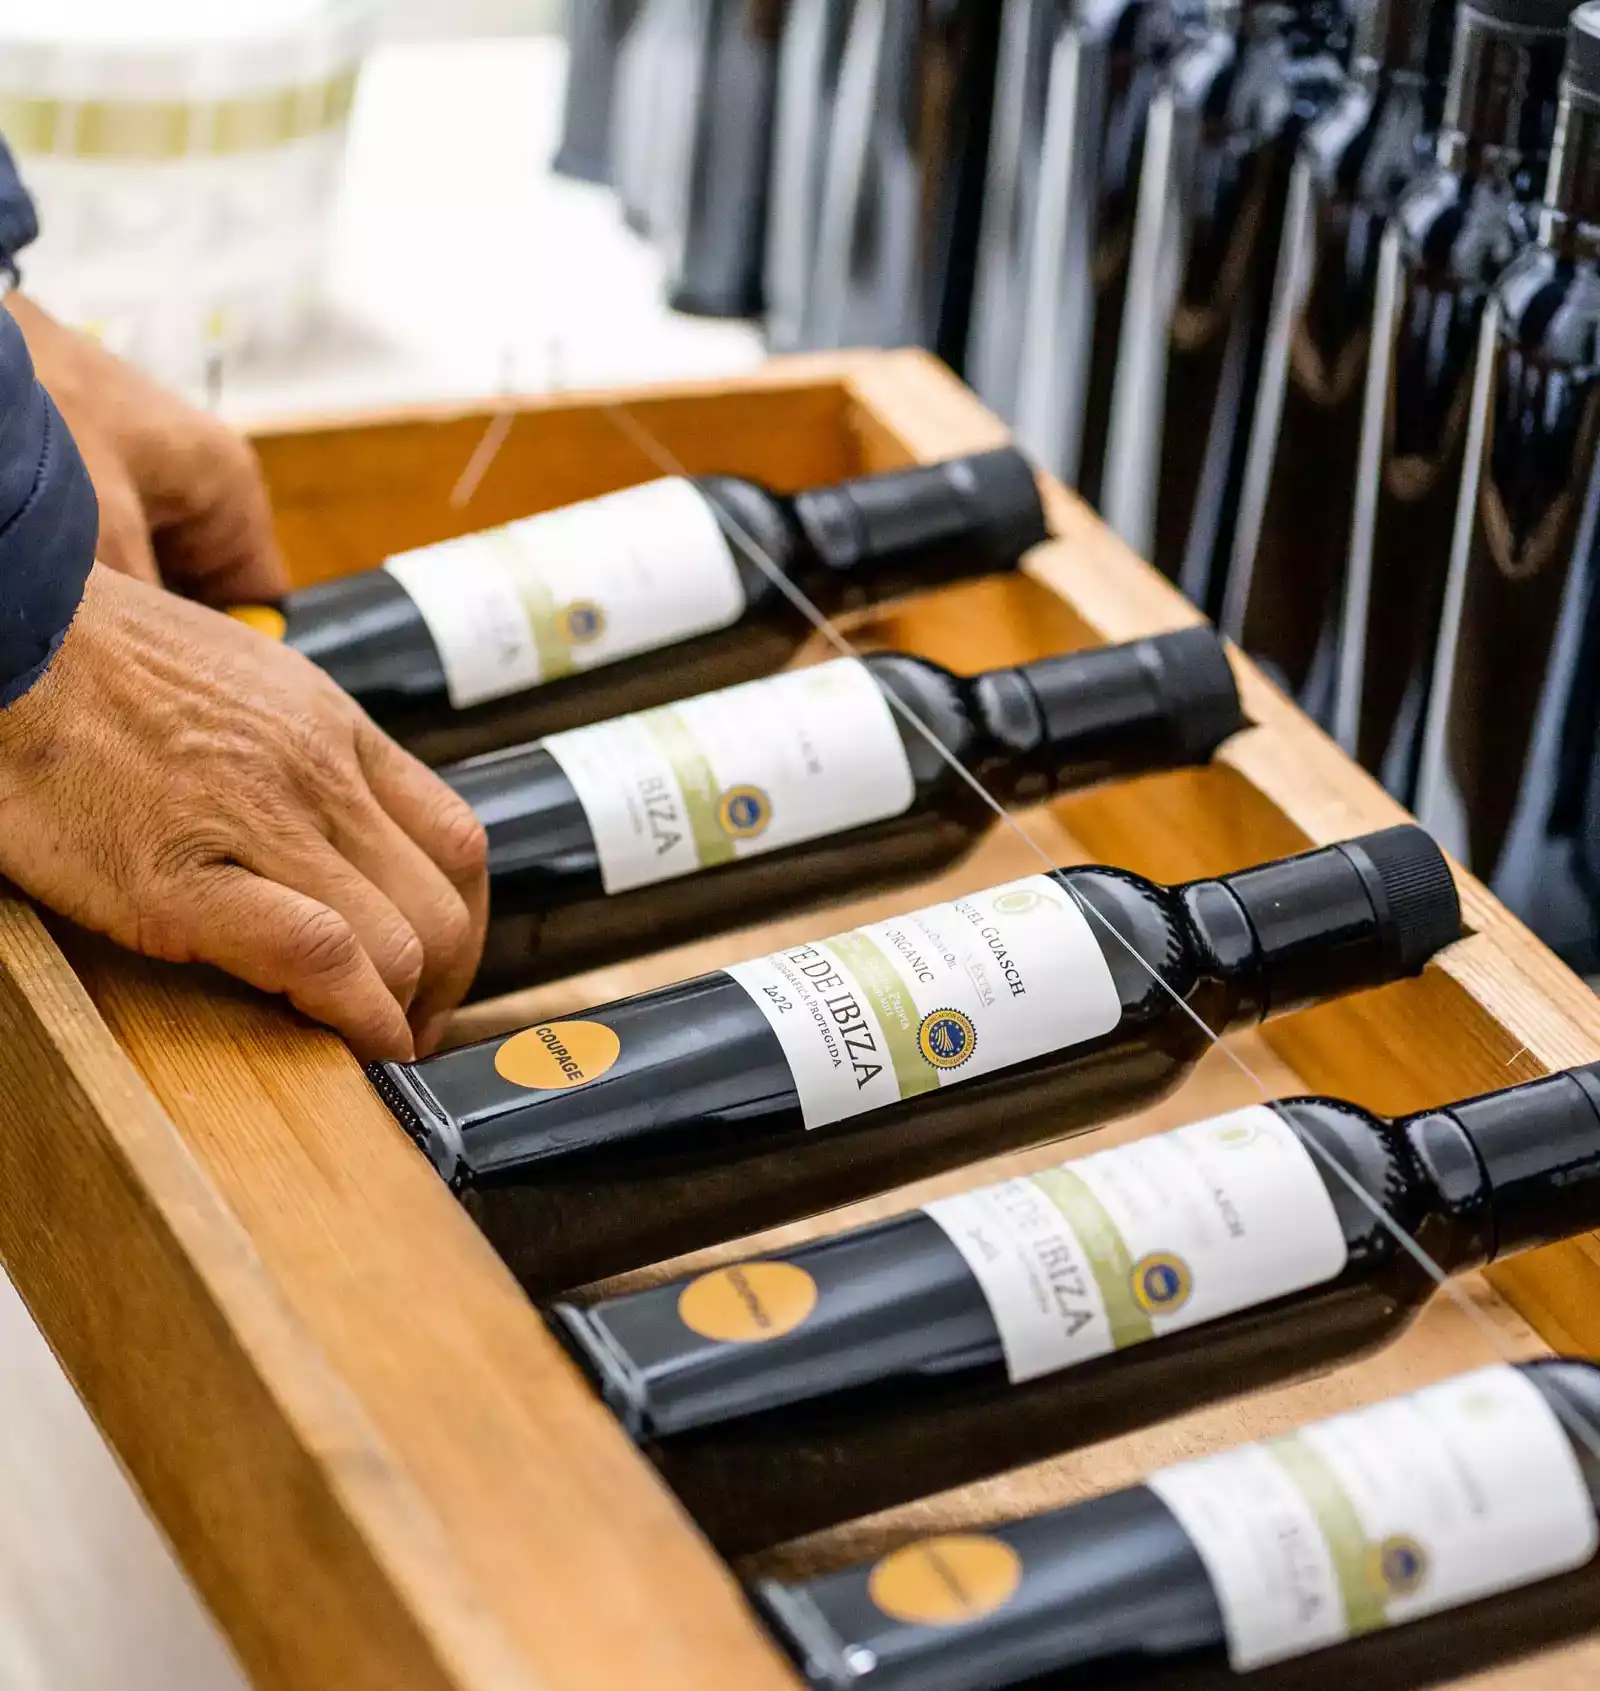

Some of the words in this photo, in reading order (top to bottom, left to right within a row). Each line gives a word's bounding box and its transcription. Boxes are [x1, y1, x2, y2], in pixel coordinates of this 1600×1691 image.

[885, 930, 934, 983] ORGANIC
[981, 927, 1026, 997] GUASCH
[762, 984, 793, 1014] 2022
[800, 960, 844, 993] DE
[823, 991, 883, 1090] IBIZA
[536, 1028, 584, 1080] COUPAGE
[806, 1000, 842, 1069] PROTEGIDA
[1033, 1234, 1094, 1338] IBIZA
